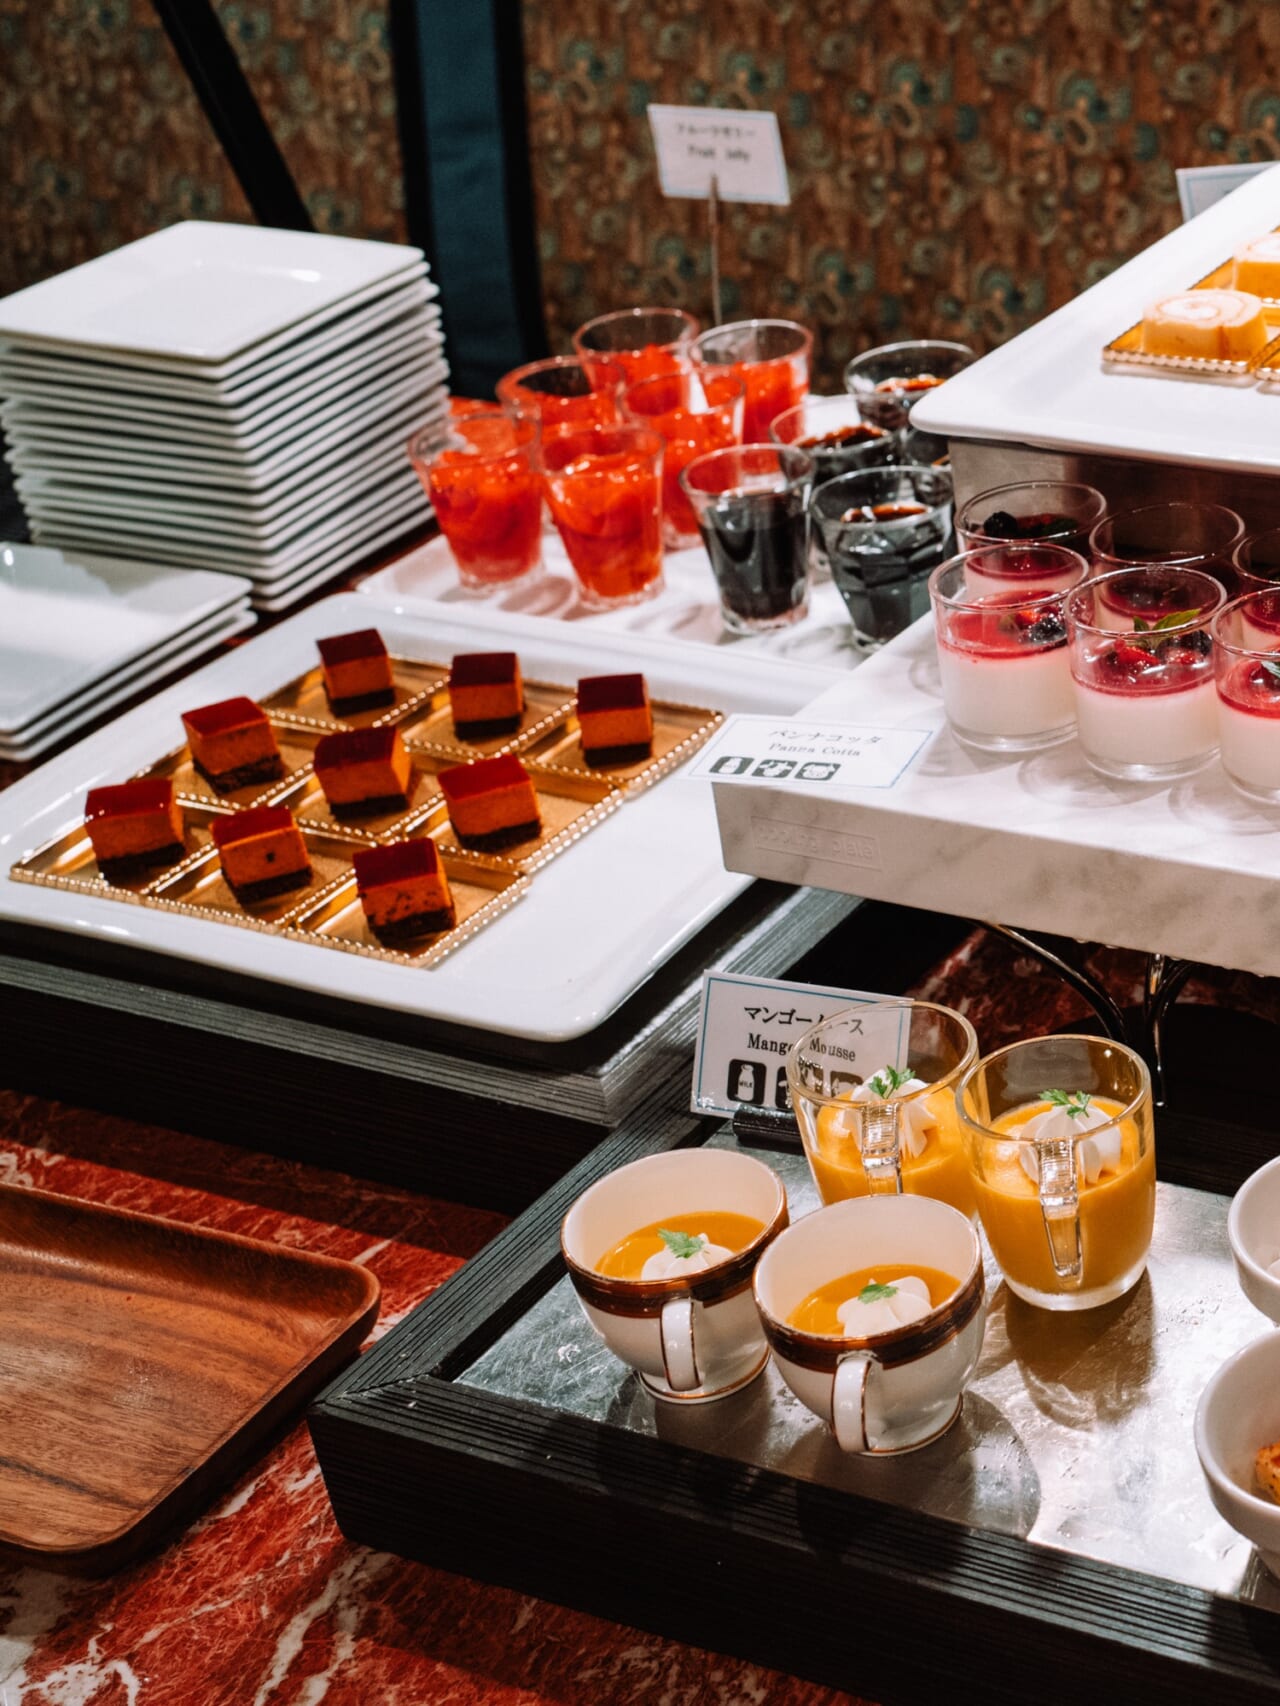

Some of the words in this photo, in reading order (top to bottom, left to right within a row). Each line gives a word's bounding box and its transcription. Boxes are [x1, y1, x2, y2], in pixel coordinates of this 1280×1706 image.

[769, 729, 883, 745] パンナコッタ
[768, 741, 816, 754] Panna
[822, 744, 861, 757] Cotta
[743, 1006, 864, 1036] マンゴーース
[809, 1036, 856, 1062] Mousse
